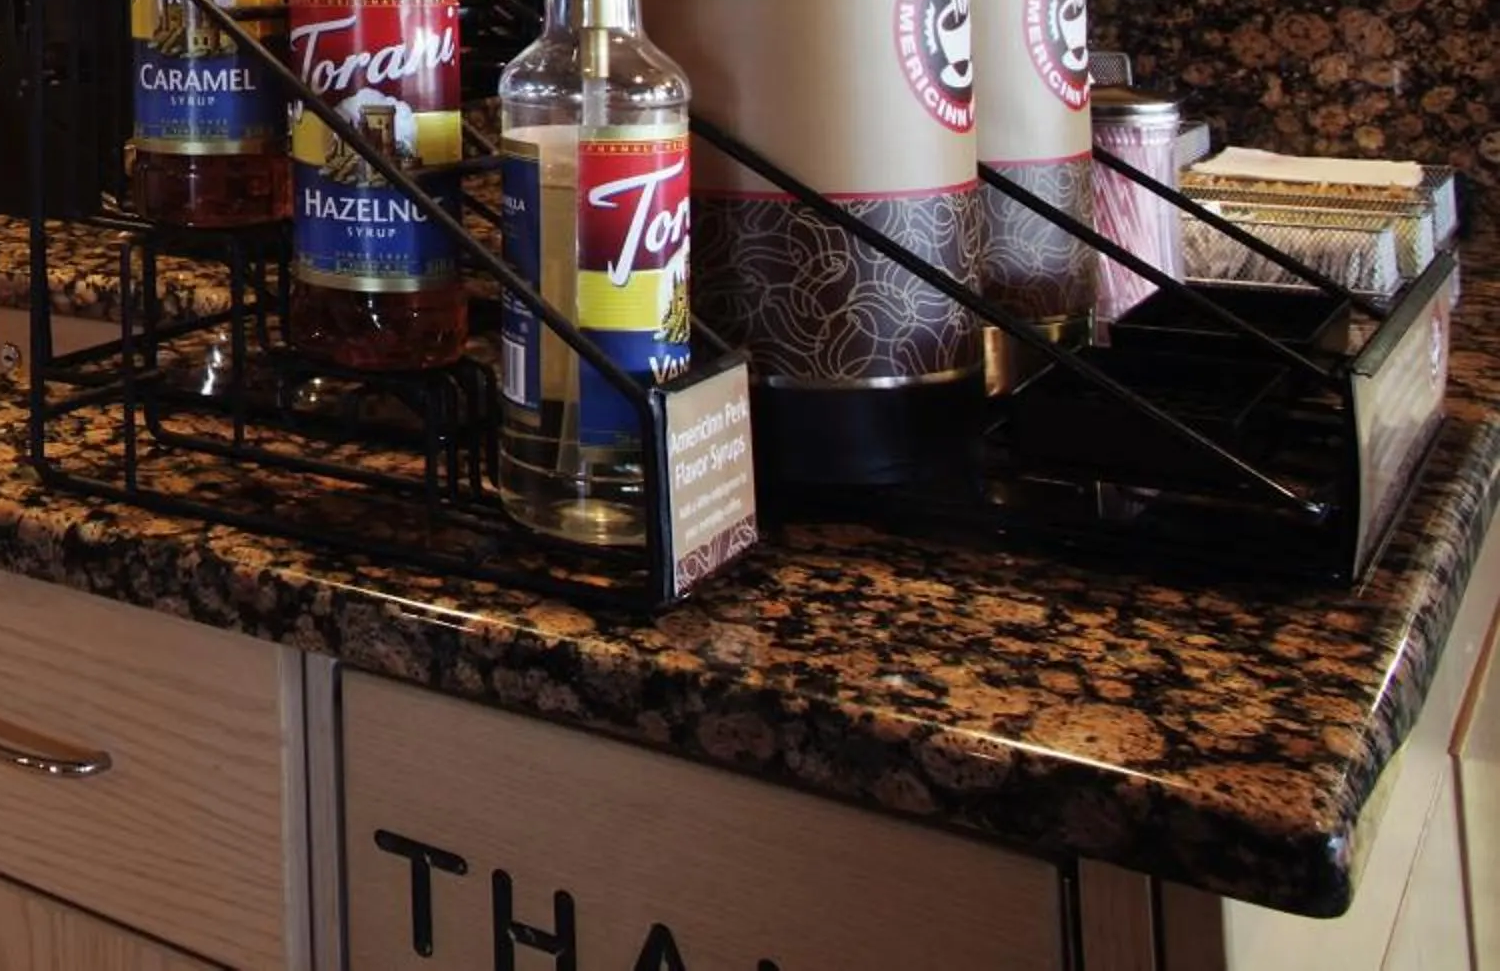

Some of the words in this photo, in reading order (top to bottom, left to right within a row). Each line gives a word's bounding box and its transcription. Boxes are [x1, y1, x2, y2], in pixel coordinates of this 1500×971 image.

[140, 63, 257, 93] CARAMEL
[305, 187, 444, 222] HAZELNU
[347, 226, 397, 239] SYRUP
[675, 452, 708, 490] Flavor
[710, 433, 746, 471] Syrups
